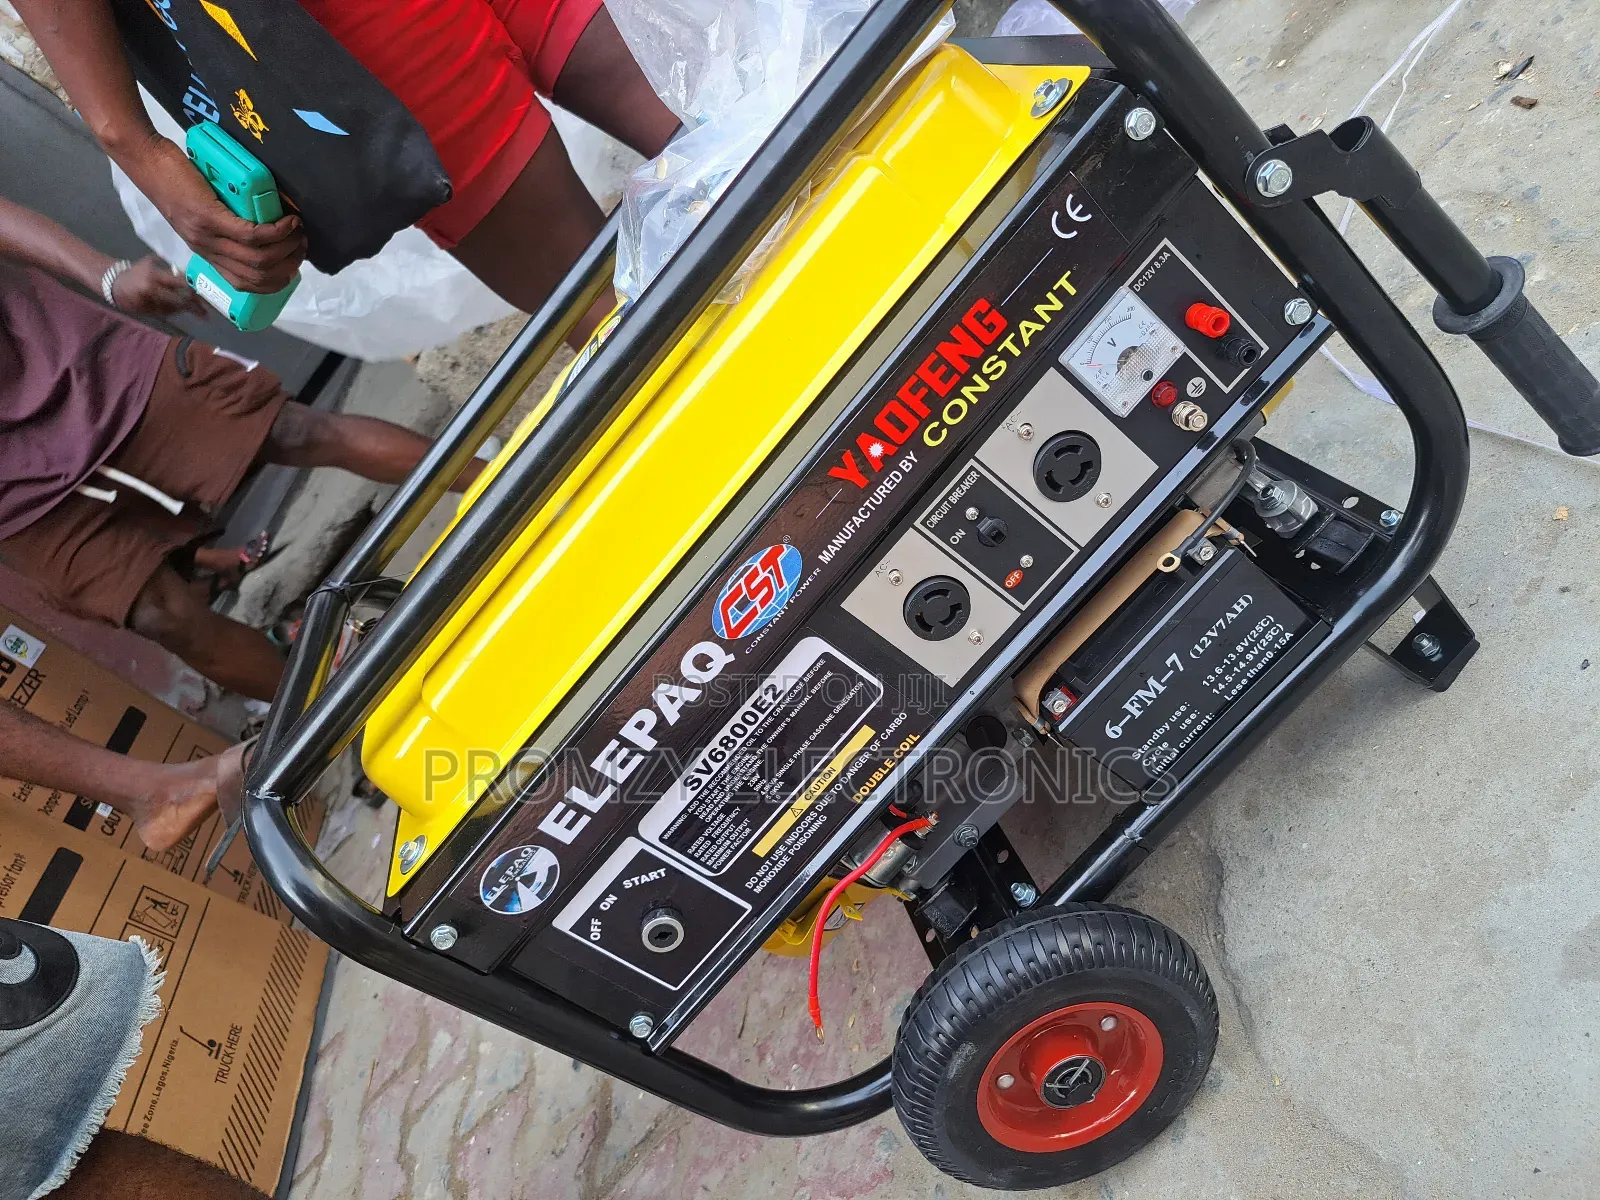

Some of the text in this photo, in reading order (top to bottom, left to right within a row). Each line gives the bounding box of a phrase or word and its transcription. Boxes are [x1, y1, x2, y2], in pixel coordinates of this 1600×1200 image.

[1043, 192, 1095, 244] CE
[1132, 249, 1171, 293] DC12V 8.3A
[917, 271, 1082, 451] CONSTANT
[1106, 337, 1118, 348] V
[827, 296, 1010, 490] YAOFENG
[817, 450, 921, 565] MANUFACTURED BY
[924, 469, 981, 529] CIRCUIT BREAKER
[948, 527, 966, 546] ON
[705, 537, 808, 644] CST
[1004, 570, 1021, 588] OFF
[743, 566, 823, 655] CONSTANT POWER
[1187, 591, 1255, 661] (12V7AH)
[9, 666, 46, 710] EZER
[536, 634, 736, 845] ELEPAQ
[662, 657, 826, 840] WARNING: ADD THE RECOMMENDED OIL TO THE CRANKCASE BEFORE
[680, 679, 785, 793] SV6800E2
[698, 669, 833, 820] READ AND UNDERSTAND THE OWNER'S MANUAL BEFORE
[1131, 720, 1171, 760] Standby
[1167, 699, 1191, 723] use:
[1140, 739, 1170, 768] Cycle
[1177, 707, 1201, 731] use:
[1151, 747, 1179, 775] Initial
[1177, 711, 1215, 749] current:
[693, 802, 707, 816] YOU
[704, 784, 723, 804] START
[720, 773, 733, 786] THE
[700, 843, 718, 862] RATED
[715, 823, 736, 845] OUTPUT
[775, 756, 795, 778] SINGLE
[792, 739, 811, 759] PHASE
[808, 712, 835, 741] GASOLINE
[832, 680, 864, 714] GENERATOR
[803, 766, 836, 802] CAUTION
[852, 730, 920, 804] DOUBLE COIL
[704, 790, 734, 823] OPERATING
[731, 779, 744, 792] THE
[744, 711, 908, 889] DO NOT USE INDOORS DUE TO DANGER OF CARBO
[687, 835, 705, 854] RATED
[702, 812, 726, 838] VOLTAGE
[693, 839, 711, 858] RATED
[711, 806, 741, 839] FREQUENCY
[706, 838, 731, 866] MAXIMUM
[728, 817, 750, 841] OUTPUT
[712, 848, 732, 869] POWER
[729, 826, 751, 850] FACTOR
[753, 813, 828, 894] MONOXIDE POISONING
[484, 845, 532, 901] ELEPAQ
[598, 892, 618, 912] ON
[623, 867, 667, 890] START
[590, 918, 600, 939] OFF
[212, 1022, 244, 1086] TRUCK HERE
